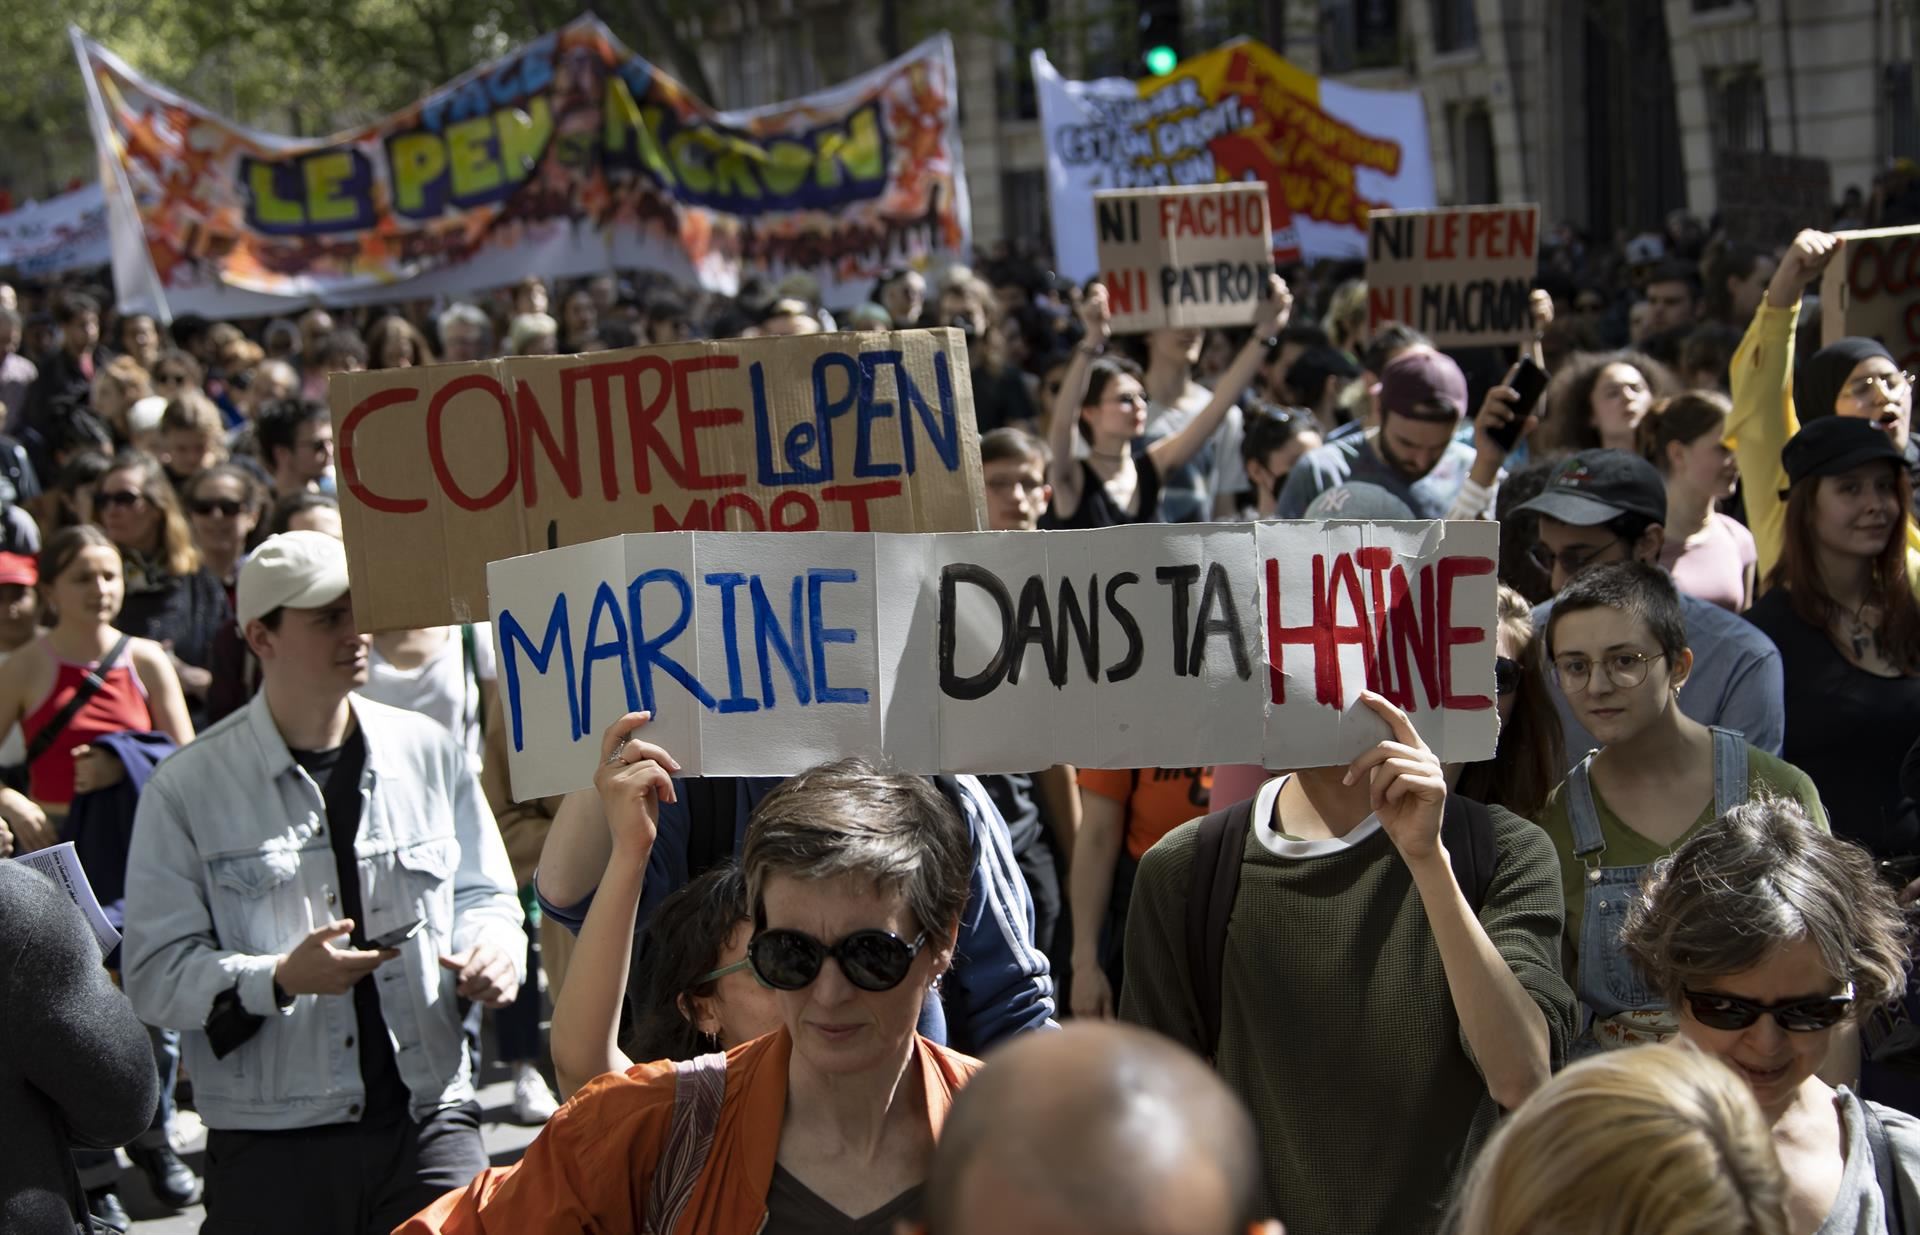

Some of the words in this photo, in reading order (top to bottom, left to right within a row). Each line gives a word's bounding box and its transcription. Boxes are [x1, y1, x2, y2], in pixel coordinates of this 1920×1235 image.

[251, 155, 358, 222] LE
[392, 97, 550, 209] PEN
[604, 76, 884, 198] MCRON
[1099, 199, 1140, 243] NI
[1159, 193, 1265, 240] FACHO
[1372, 216, 1414, 262] NI
[1105, 269, 1148, 316] NI
[1369, 285, 1415, 336] NI
[1420, 277, 1537, 333] MACRON
[338, 355, 748, 513] CONTRE
[498, 567, 870, 753] MARINE
[938, 561, 1144, 701] DANS
[1155, 561, 1252, 683] TA
[1264, 546, 1496, 713] HAINE
